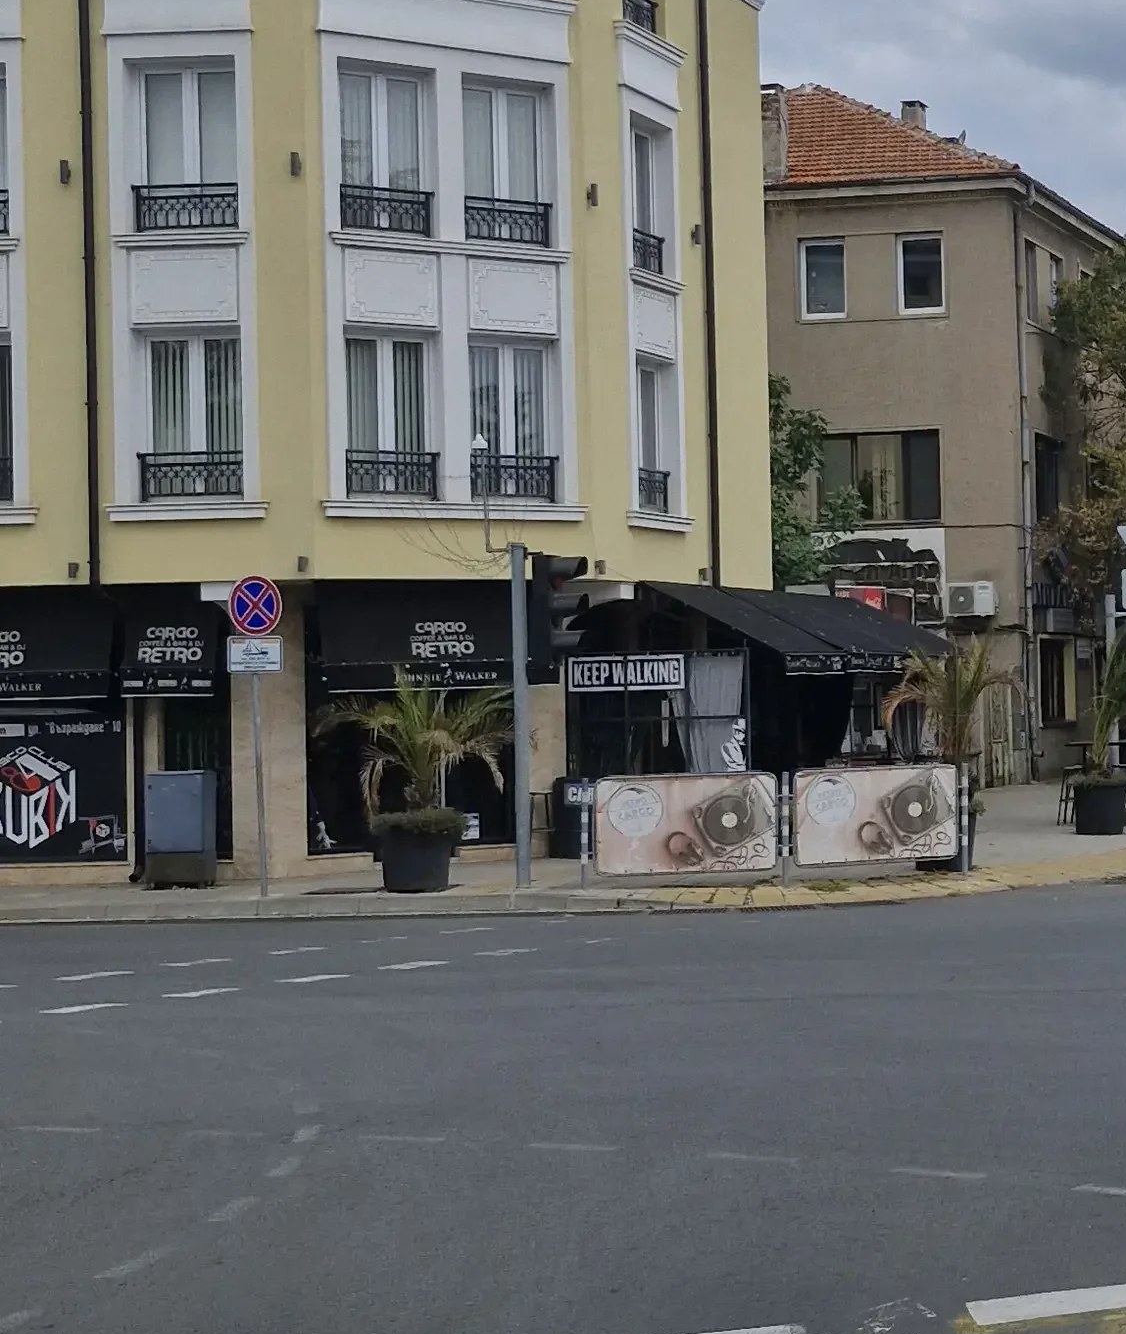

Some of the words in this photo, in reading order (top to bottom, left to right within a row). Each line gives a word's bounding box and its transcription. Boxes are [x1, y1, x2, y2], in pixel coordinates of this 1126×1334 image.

[146, 626, 199, 640] CARGO
[415, 621, 467, 635] CARGO
[137, 647, 203, 664] RETRO
[410, 641, 475, 658] RETRO
[454, 670, 498, 681] WALKER
[573, 662, 610, 686] KEEP
[612, 659, 680, 685] WALKING
[0, 769, 76, 849] UBIK
